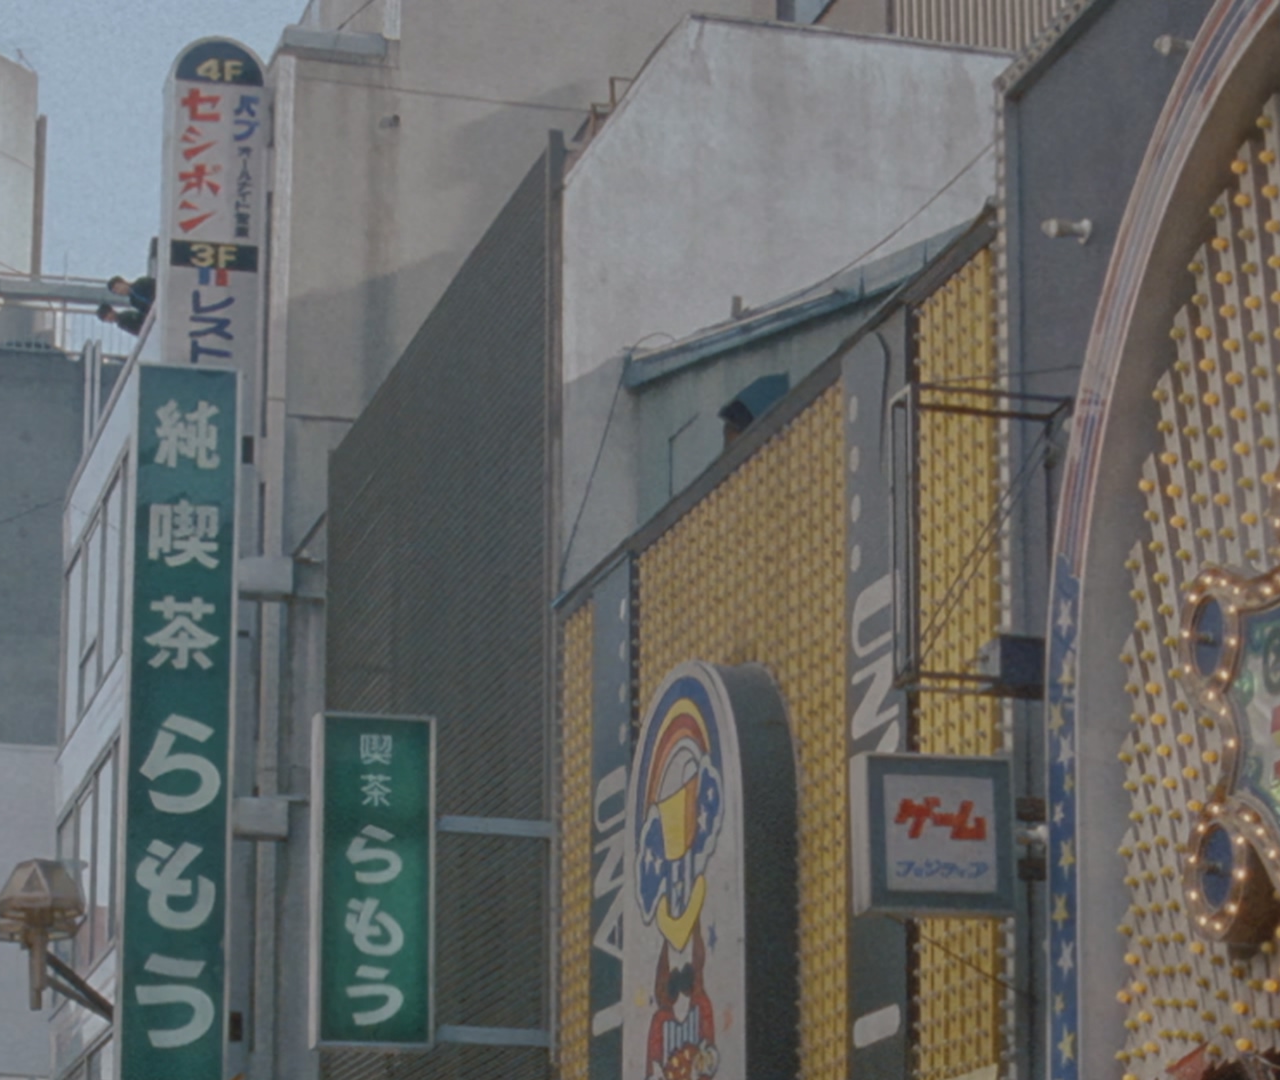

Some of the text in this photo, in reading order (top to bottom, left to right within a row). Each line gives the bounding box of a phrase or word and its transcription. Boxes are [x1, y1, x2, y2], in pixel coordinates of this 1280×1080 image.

[196, 58, 243, 82] 4F
[179, 87, 221, 233] セシボン
[190, 243, 238, 268] 3F
[894, 796, 987, 840] ゲーム
